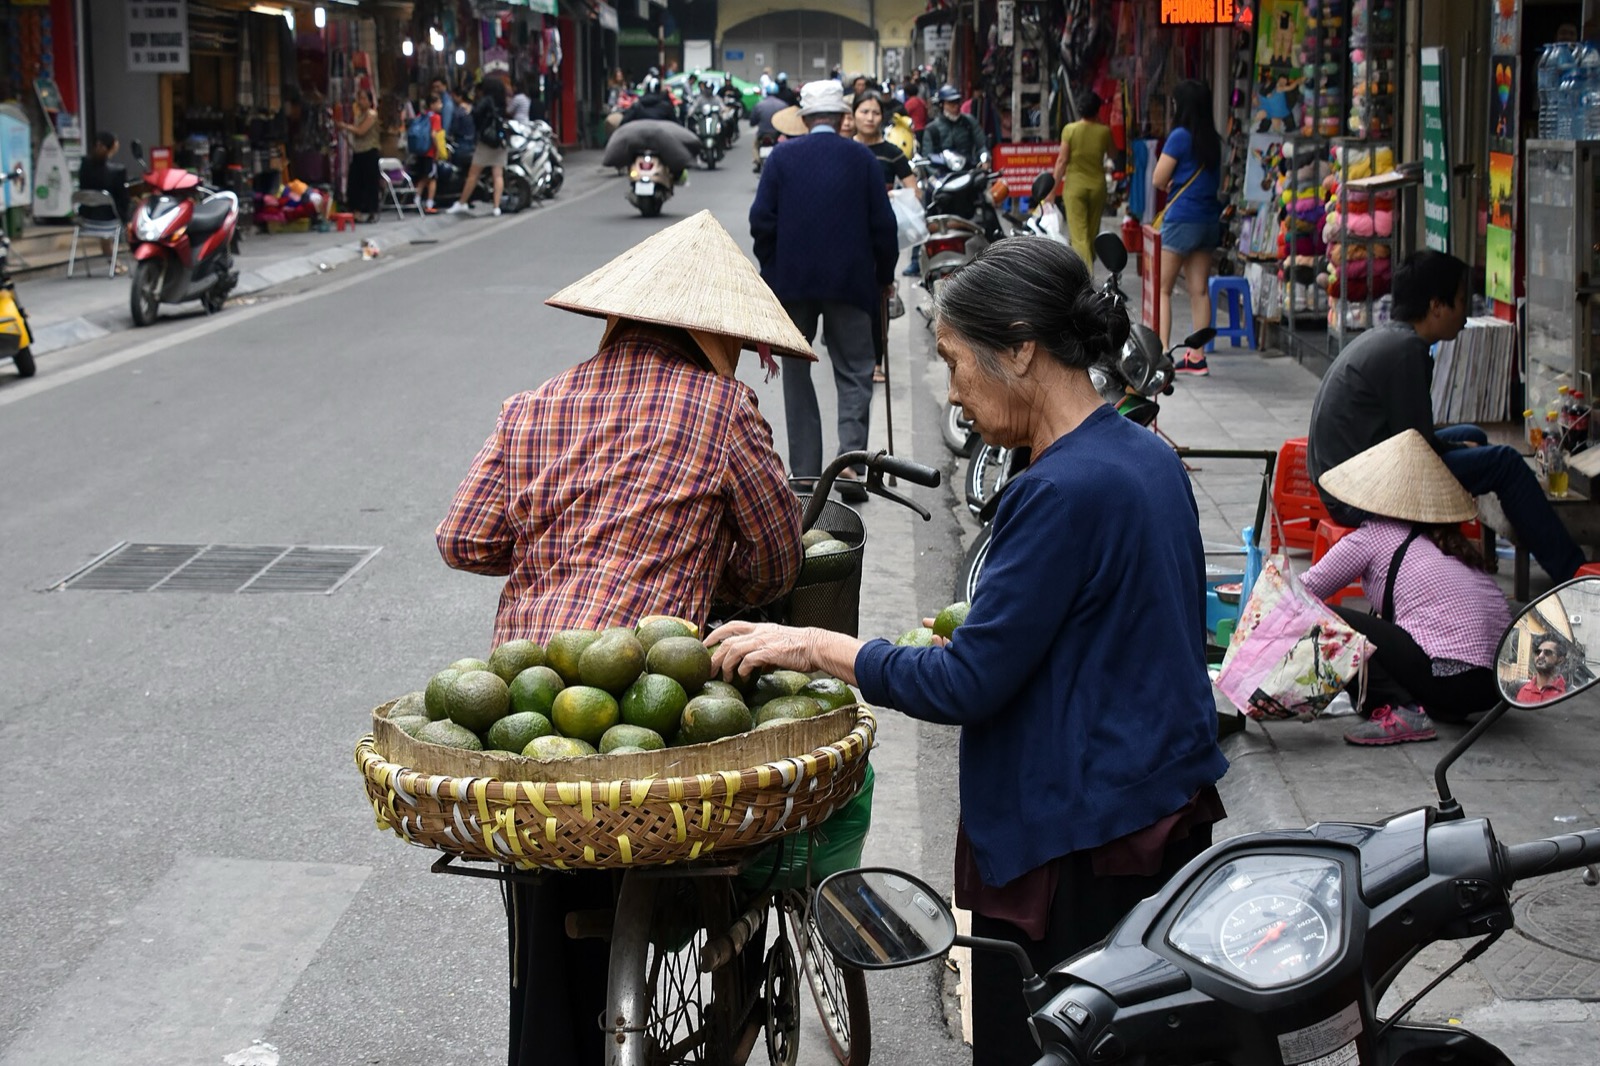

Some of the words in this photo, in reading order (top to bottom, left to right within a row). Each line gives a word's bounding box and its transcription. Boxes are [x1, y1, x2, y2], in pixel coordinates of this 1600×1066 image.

[1270, 901, 1285, 911] 100
[1287, 907, 1302, 917] 120
[1297, 918, 1312, 928] 140
[1237, 946, 1250, 956] 20
